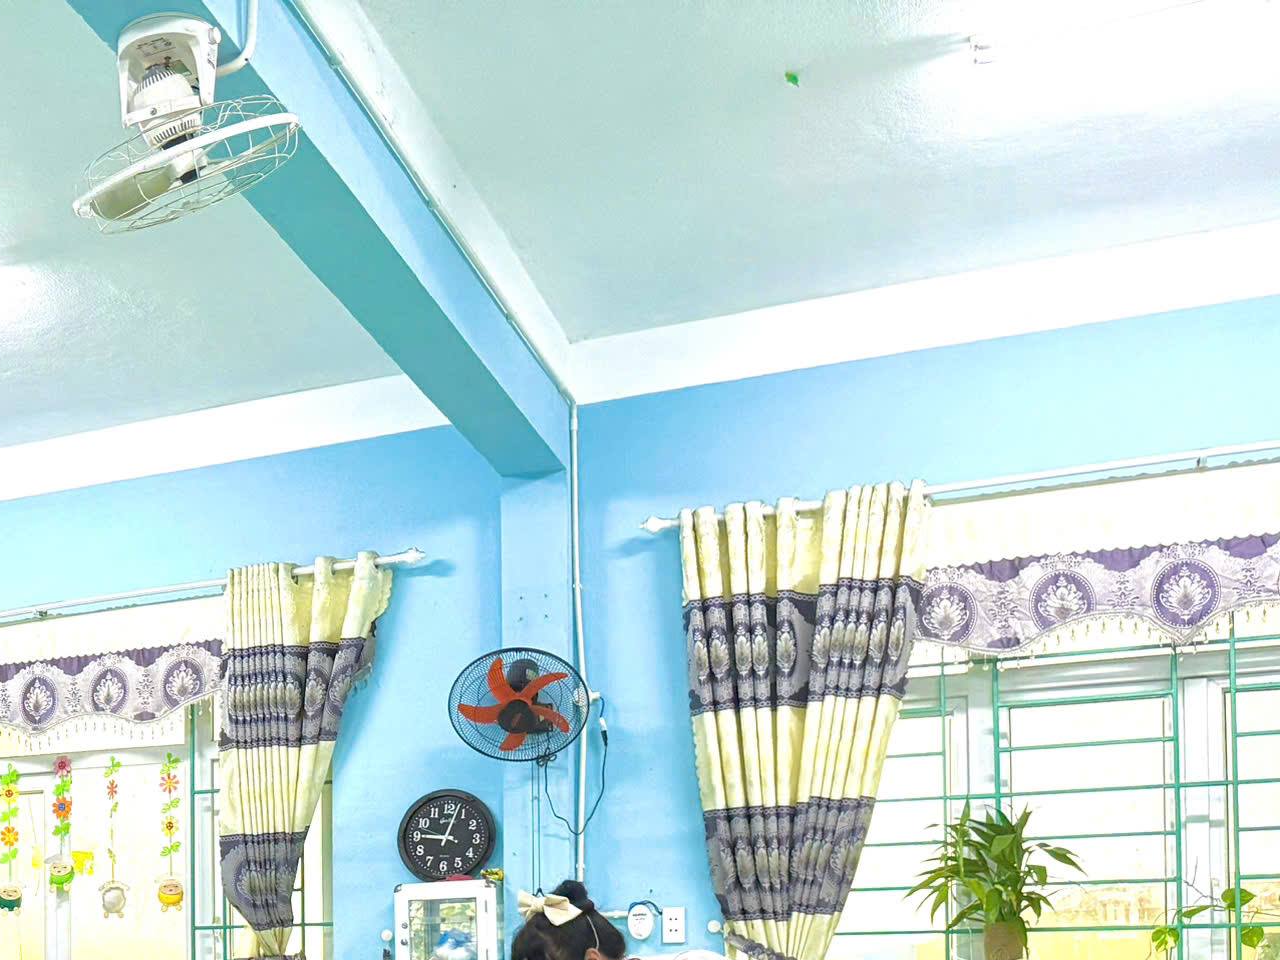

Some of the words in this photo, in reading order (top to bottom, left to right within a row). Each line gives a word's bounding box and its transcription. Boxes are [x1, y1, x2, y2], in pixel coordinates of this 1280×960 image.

[430, 807, 439, 818] 11
[443, 803, 456, 815] 12
[461, 808, 466, 819] 1
[419, 817, 430, 829] 10
[468, 819, 477, 830] 2
[413, 830, 421, 842] 9
[472, 833, 481, 844] 3
[416, 844, 424, 856] 8
[465, 847, 474, 858] 4
[425, 855, 434, 867] 7
[439, 860, 448, 872] 6
[454, 857, 462, 868] 5
